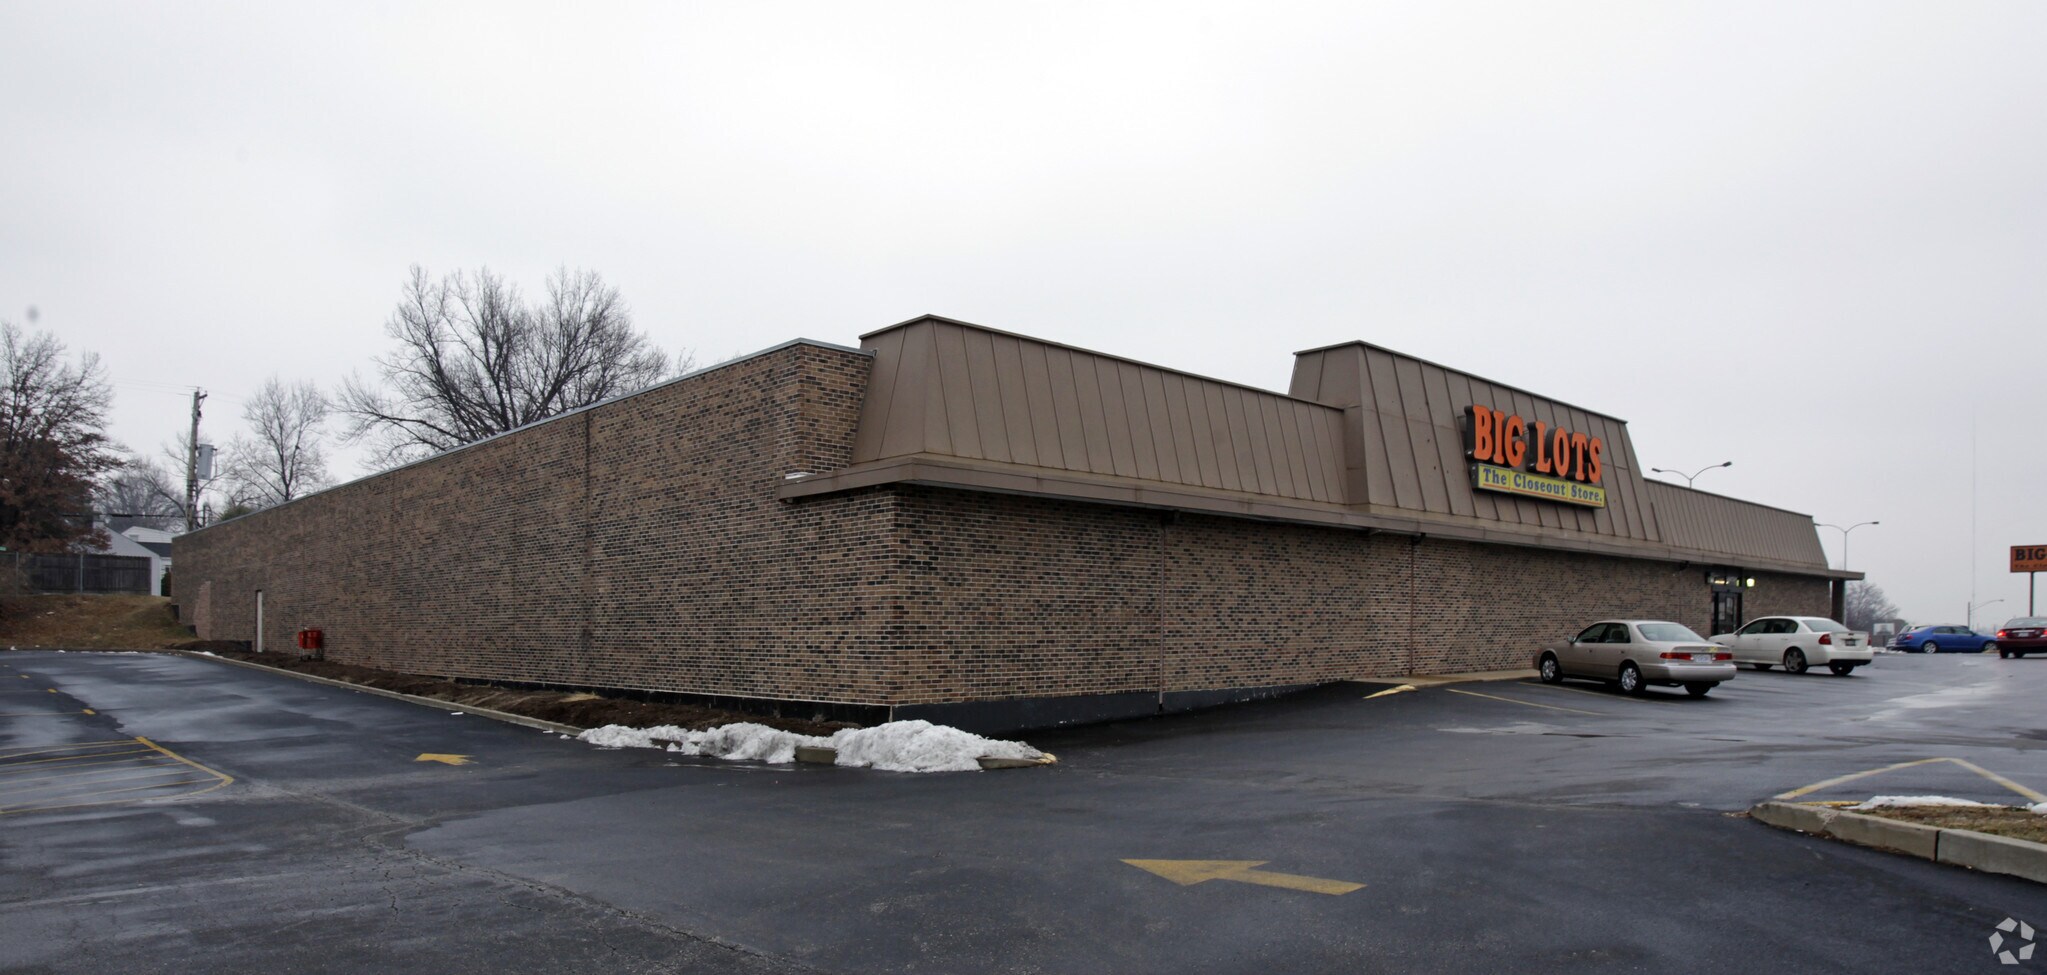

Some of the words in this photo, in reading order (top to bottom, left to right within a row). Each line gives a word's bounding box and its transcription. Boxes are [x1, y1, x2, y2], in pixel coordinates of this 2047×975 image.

[1473, 405, 1526, 467] BIG
[1535, 421, 1602, 483] LOTS
[1482, 468, 1507, 486] The
[1514, 474, 1567, 495] Closeout
[1571, 484, 1603, 503] Store.
[2014, 547, 2047, 561] BIG
